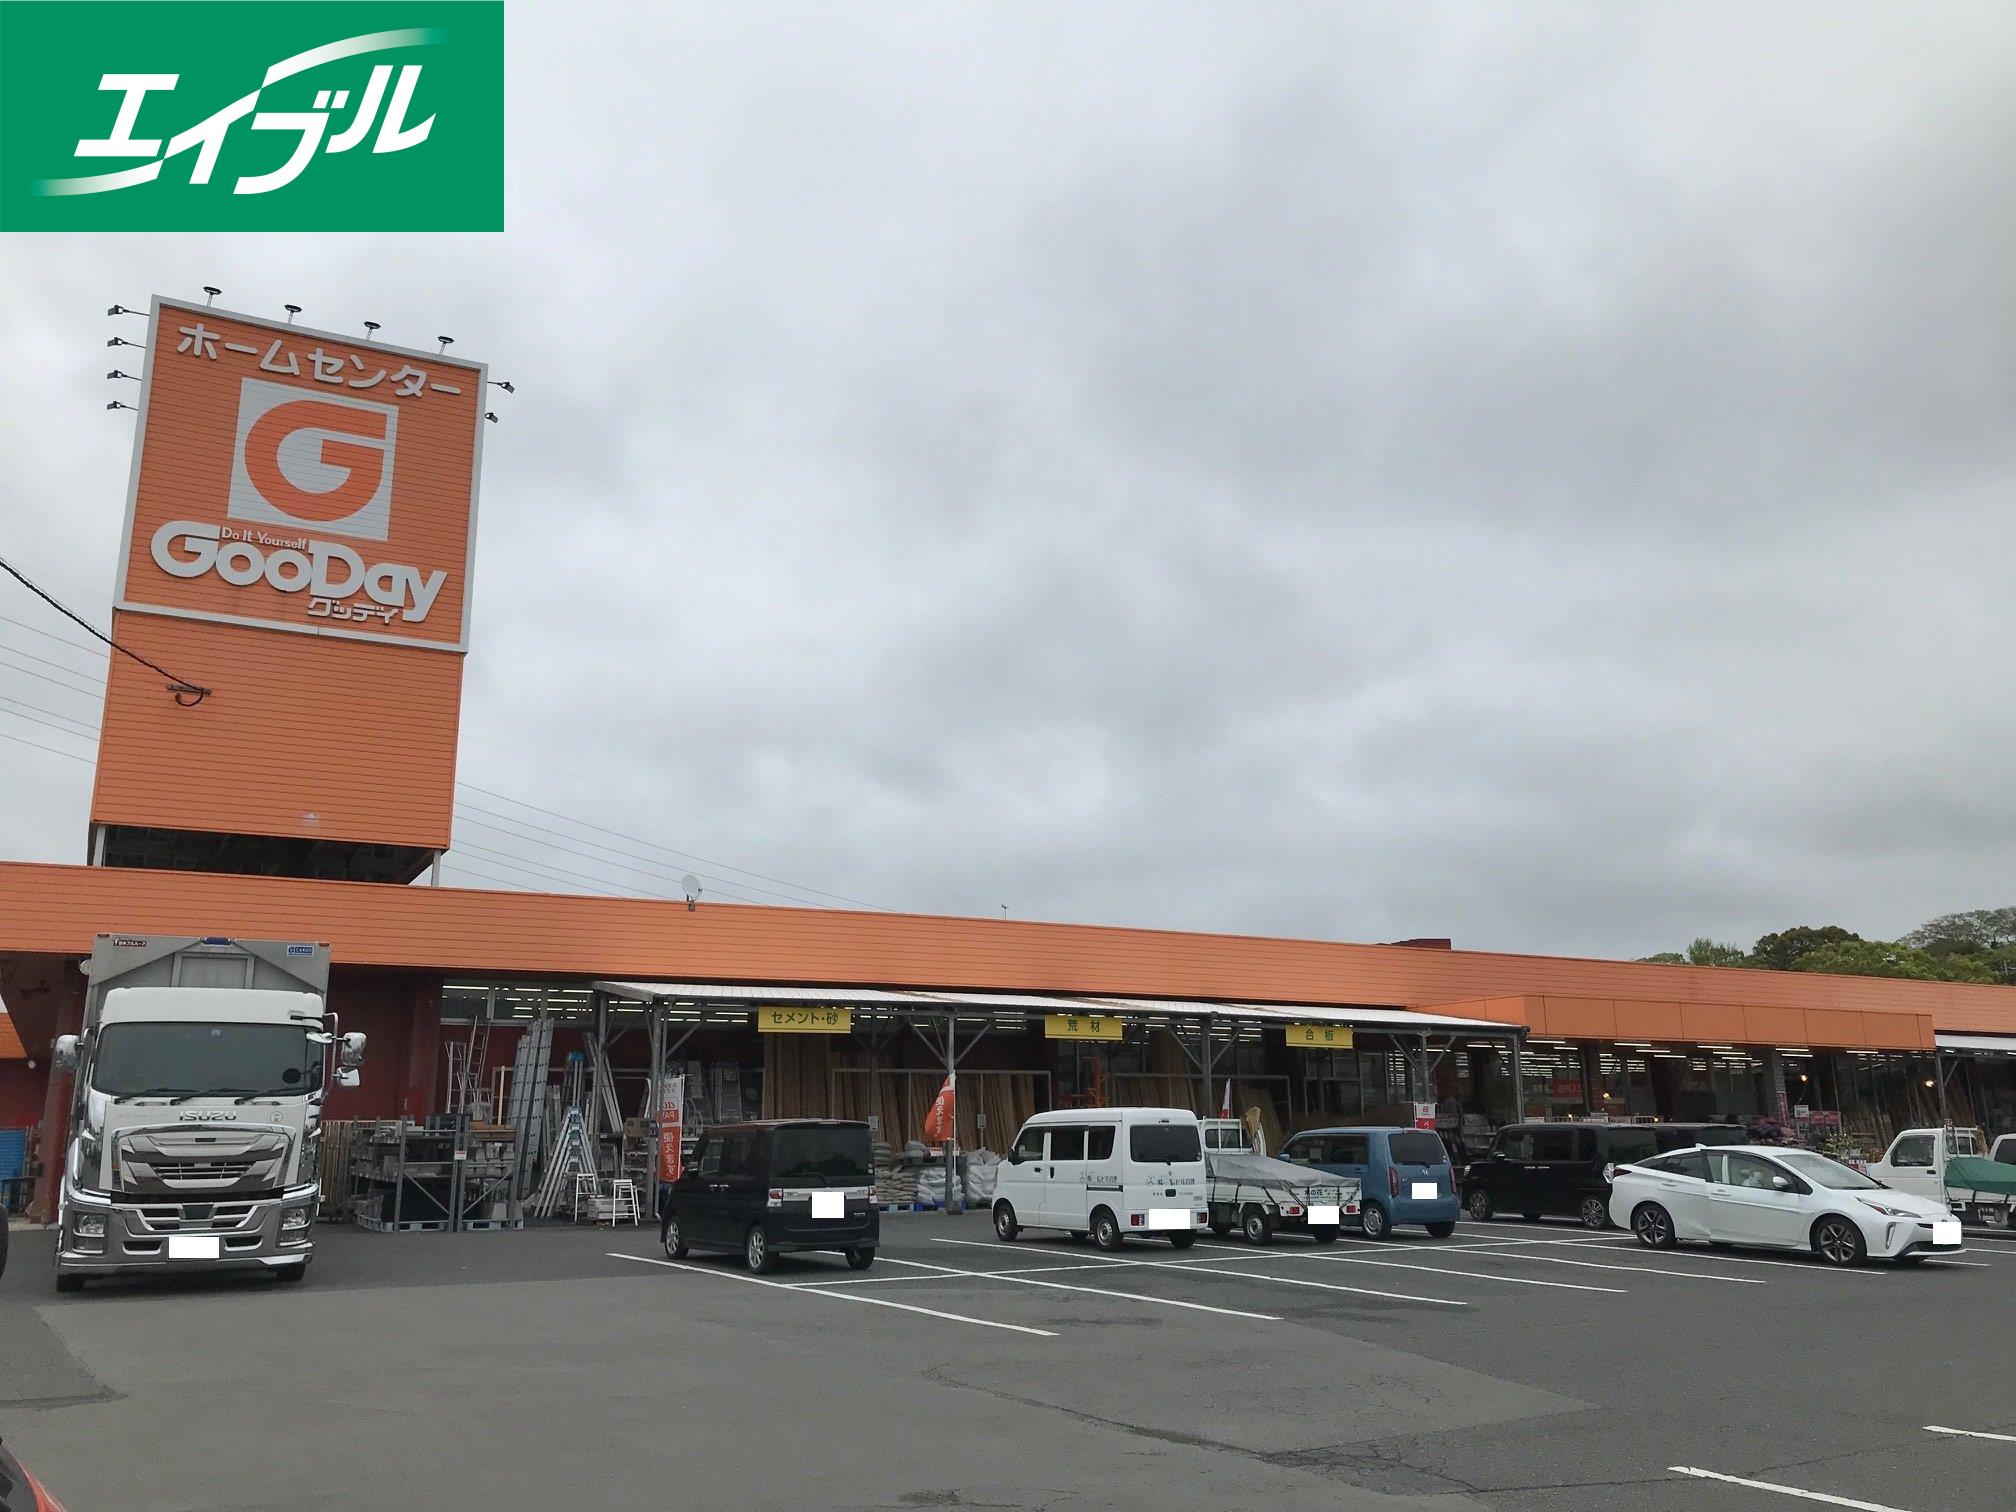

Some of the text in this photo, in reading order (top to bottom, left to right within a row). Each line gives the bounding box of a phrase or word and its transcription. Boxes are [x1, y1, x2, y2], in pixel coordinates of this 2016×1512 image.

[177, 322, 462, 399] ホームセンター
[244, 399, 388, 522] G
[221, 526, 308, 550] Do It Yourself
[771, 1011, 839, 1026] セメント・砂
[179, 1110, 237, 1121] ISUZU
